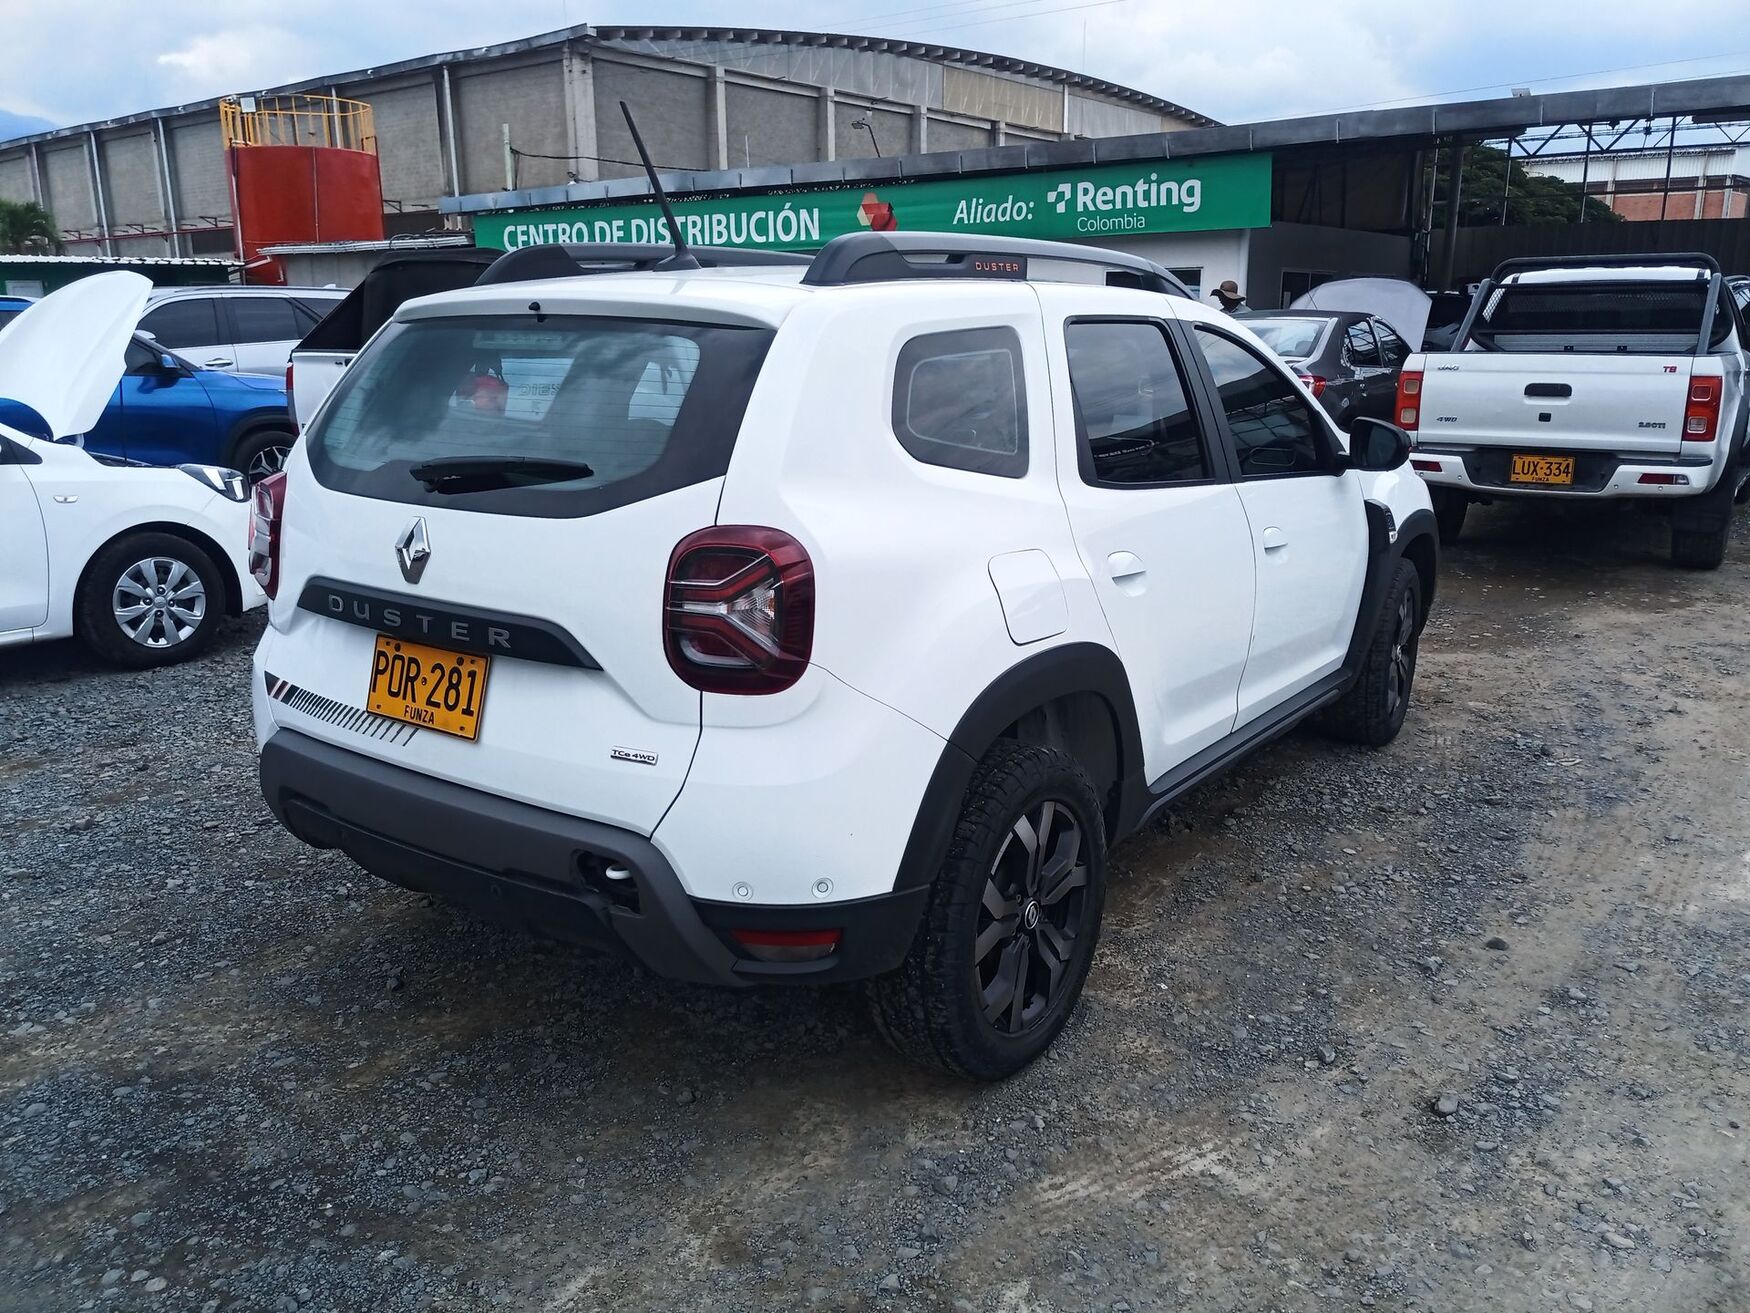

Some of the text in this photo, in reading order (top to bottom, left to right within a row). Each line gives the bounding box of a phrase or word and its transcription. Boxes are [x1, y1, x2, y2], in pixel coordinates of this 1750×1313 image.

[1076, 173, 1201, 213] Renting
[953, 195, 1034, 225] Aliado:
[1077, 213, 1146, 232] Colombia
[503, 202, 819, 252] CENTRO DE DISTRIBUCIÓN
[975, 261, 1019, 272] DUSTER
[328, 593, 512, 649] DUSTER
[403, 704, 435, 725] FUNZA
[632, 752, 656, 762] 4WD
